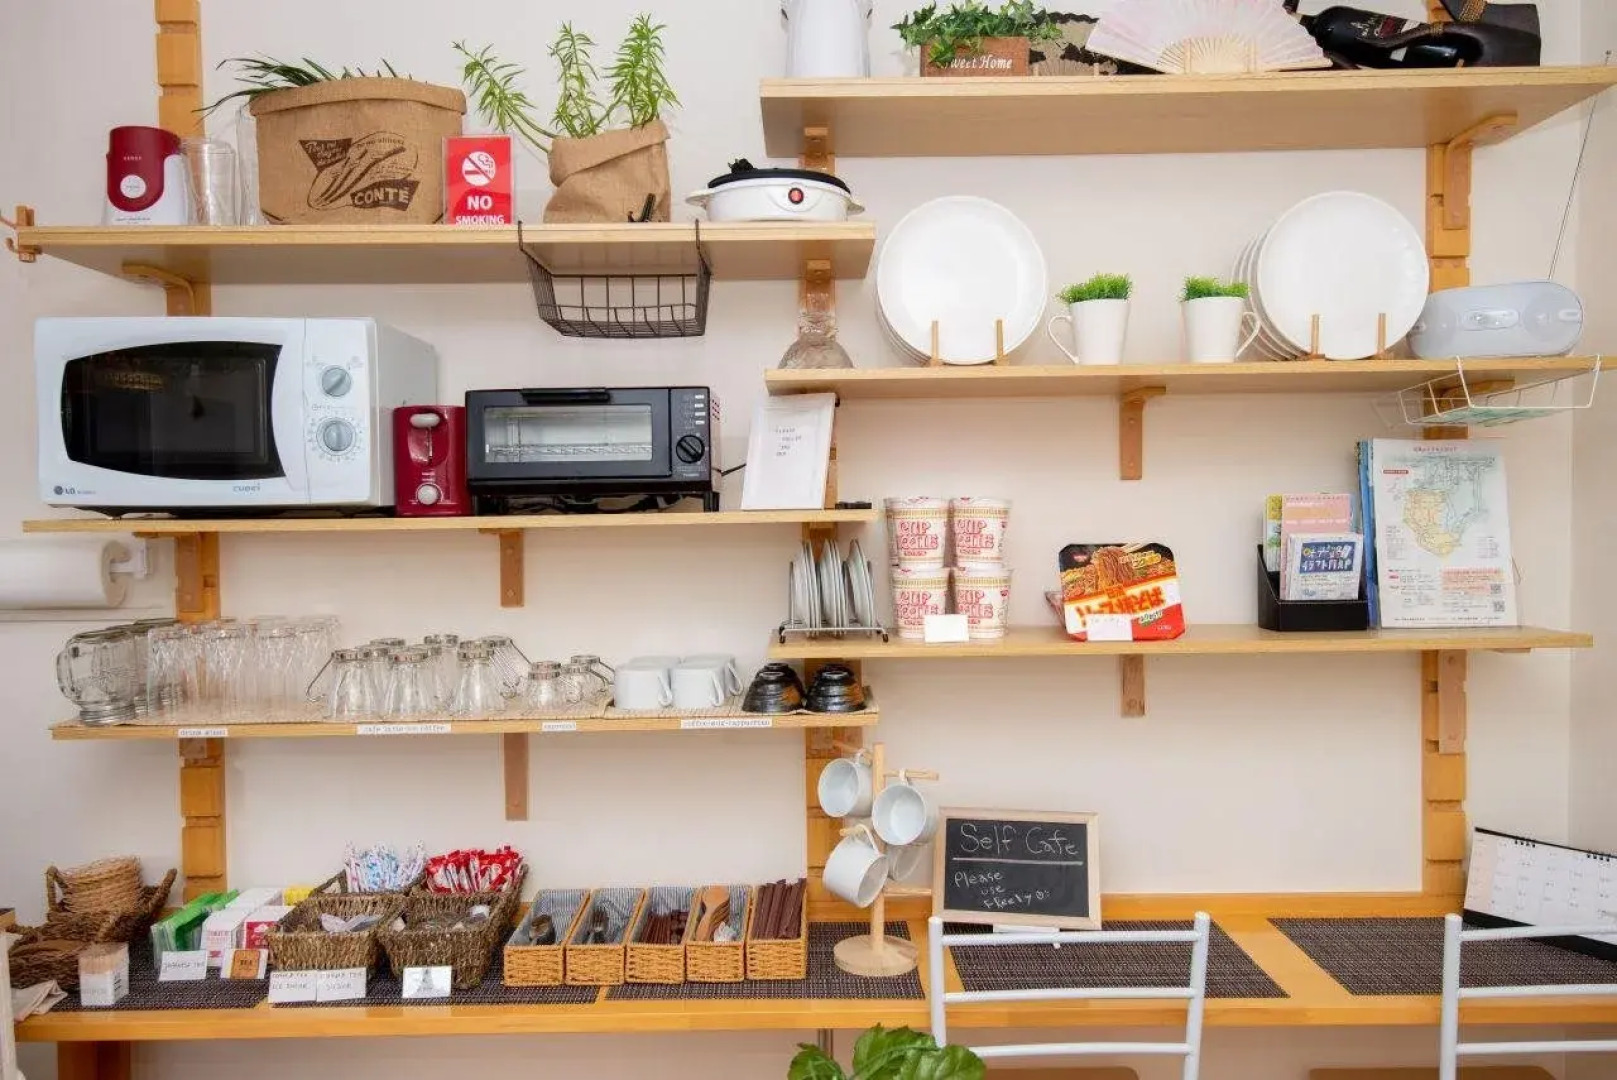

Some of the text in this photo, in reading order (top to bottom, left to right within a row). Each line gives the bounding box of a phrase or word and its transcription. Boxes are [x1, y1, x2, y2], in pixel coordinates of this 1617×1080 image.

[946, 54, 1012, 69] weet Home
[467, 195, 492, 210] NO
[456, 215, 505, 225] SMOKING
[960, 823, 1079, 855] Self Cafe
[953, 871, 1003, 888] Please
[980, 885, 1005, 896] use
